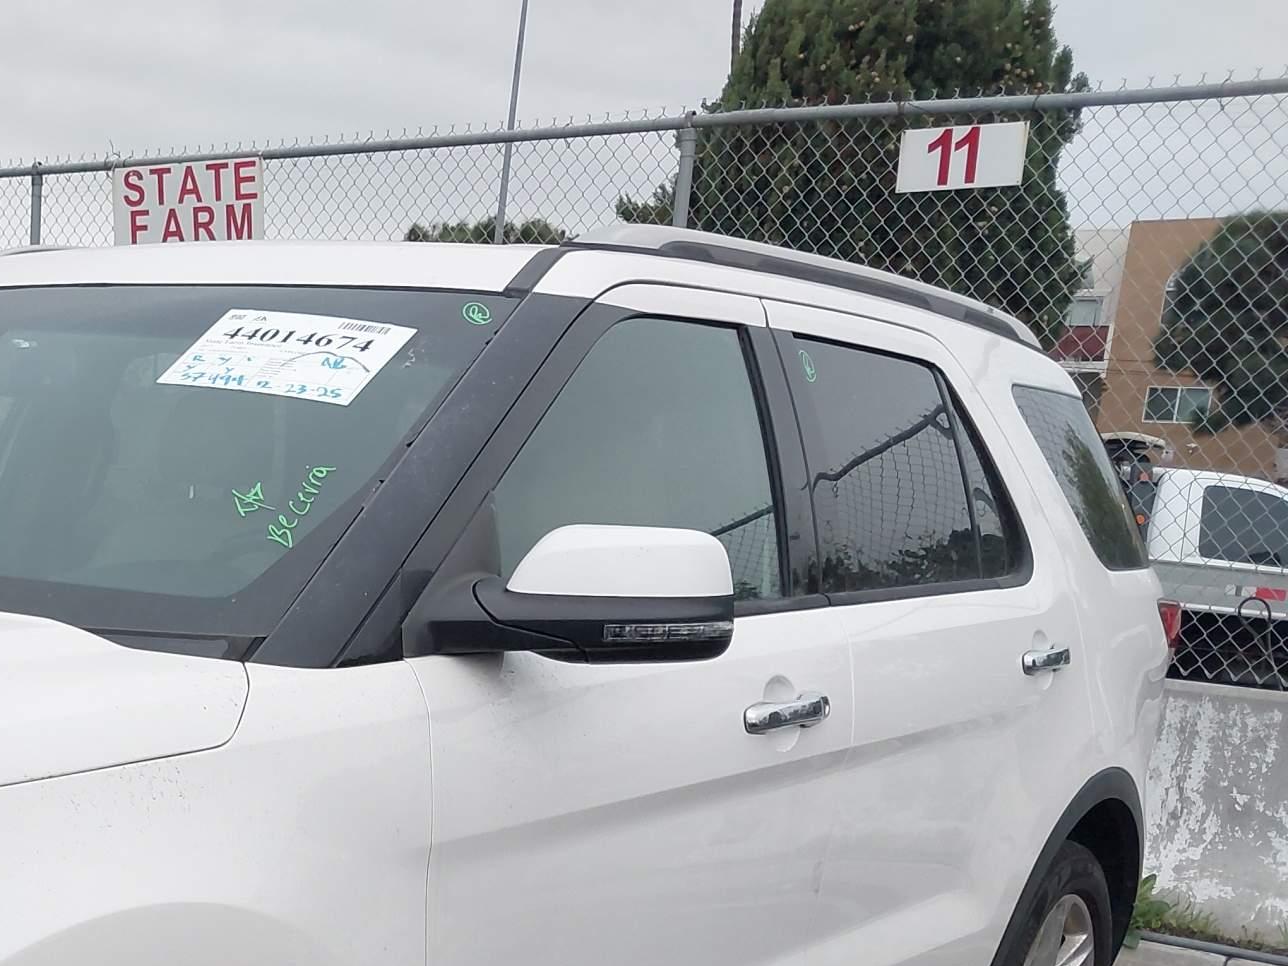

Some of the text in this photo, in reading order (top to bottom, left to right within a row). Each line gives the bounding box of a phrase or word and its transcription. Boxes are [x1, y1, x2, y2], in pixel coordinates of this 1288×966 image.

[927, 126, 981, 186] 11
[123, 160, 258, 207] STATE
[130, 202, 253, 245] FARM
[223, 326, 375, 352] 44014674
